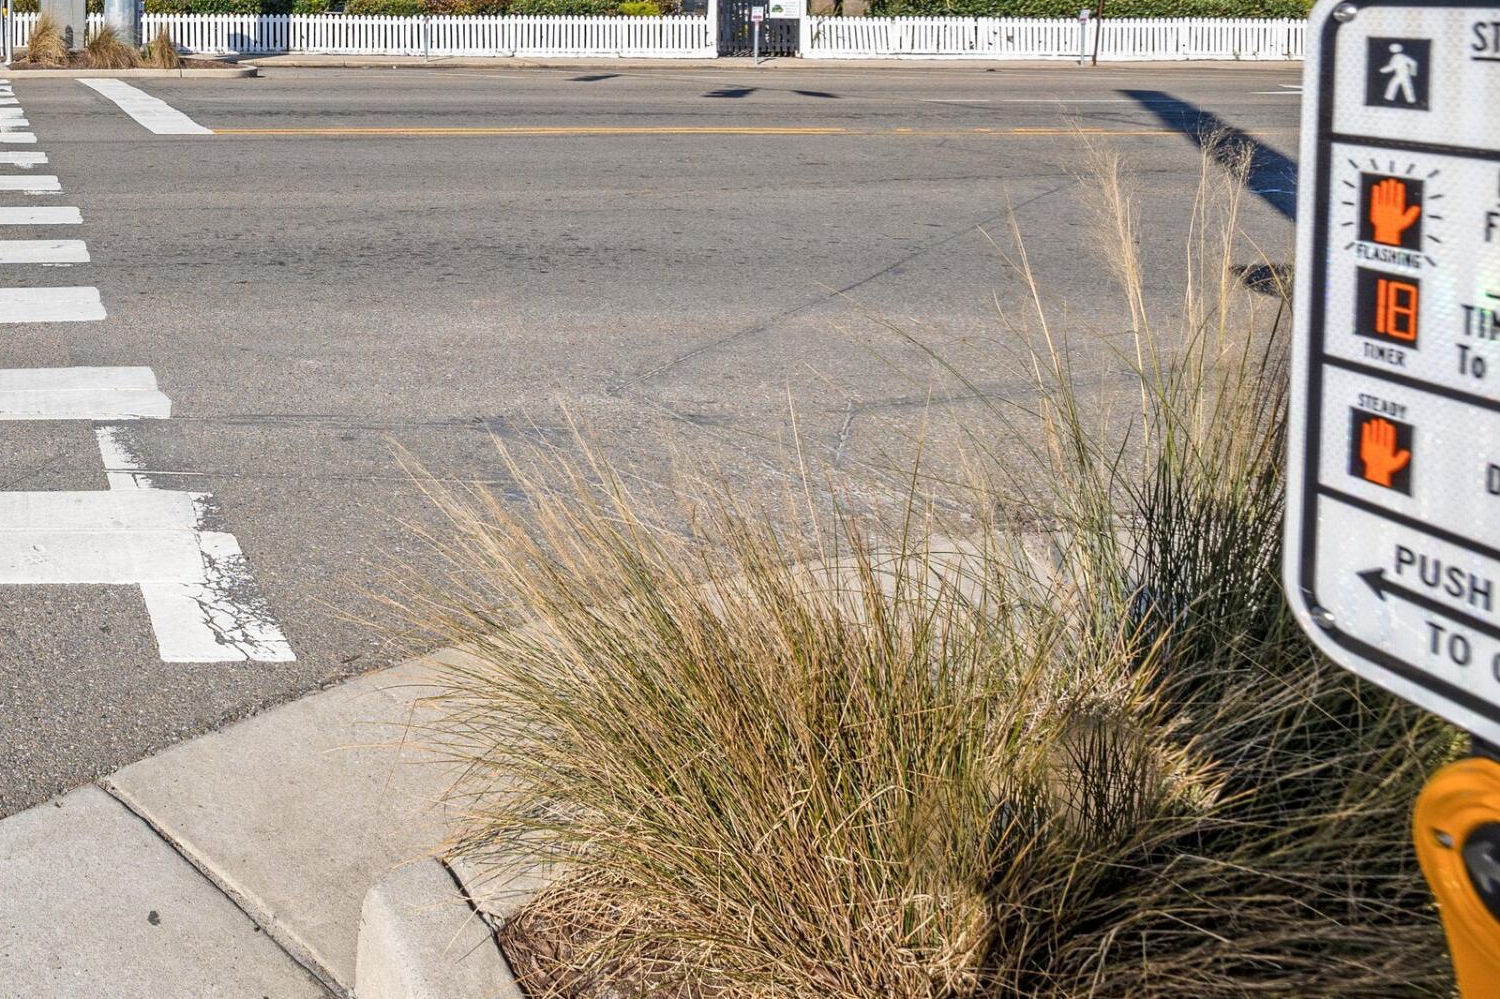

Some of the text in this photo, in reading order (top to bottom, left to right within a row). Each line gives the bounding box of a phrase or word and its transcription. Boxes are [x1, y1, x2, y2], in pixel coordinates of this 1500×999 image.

[1356, 243, 1422, 269] FLASHING
[1363, 341, 1407, 367] TIMER
[1357, 393, 1408, 419] STEADY
[1393, 543, 1495, 613] PUSH
[1425, 620, 1472, 667] TO
